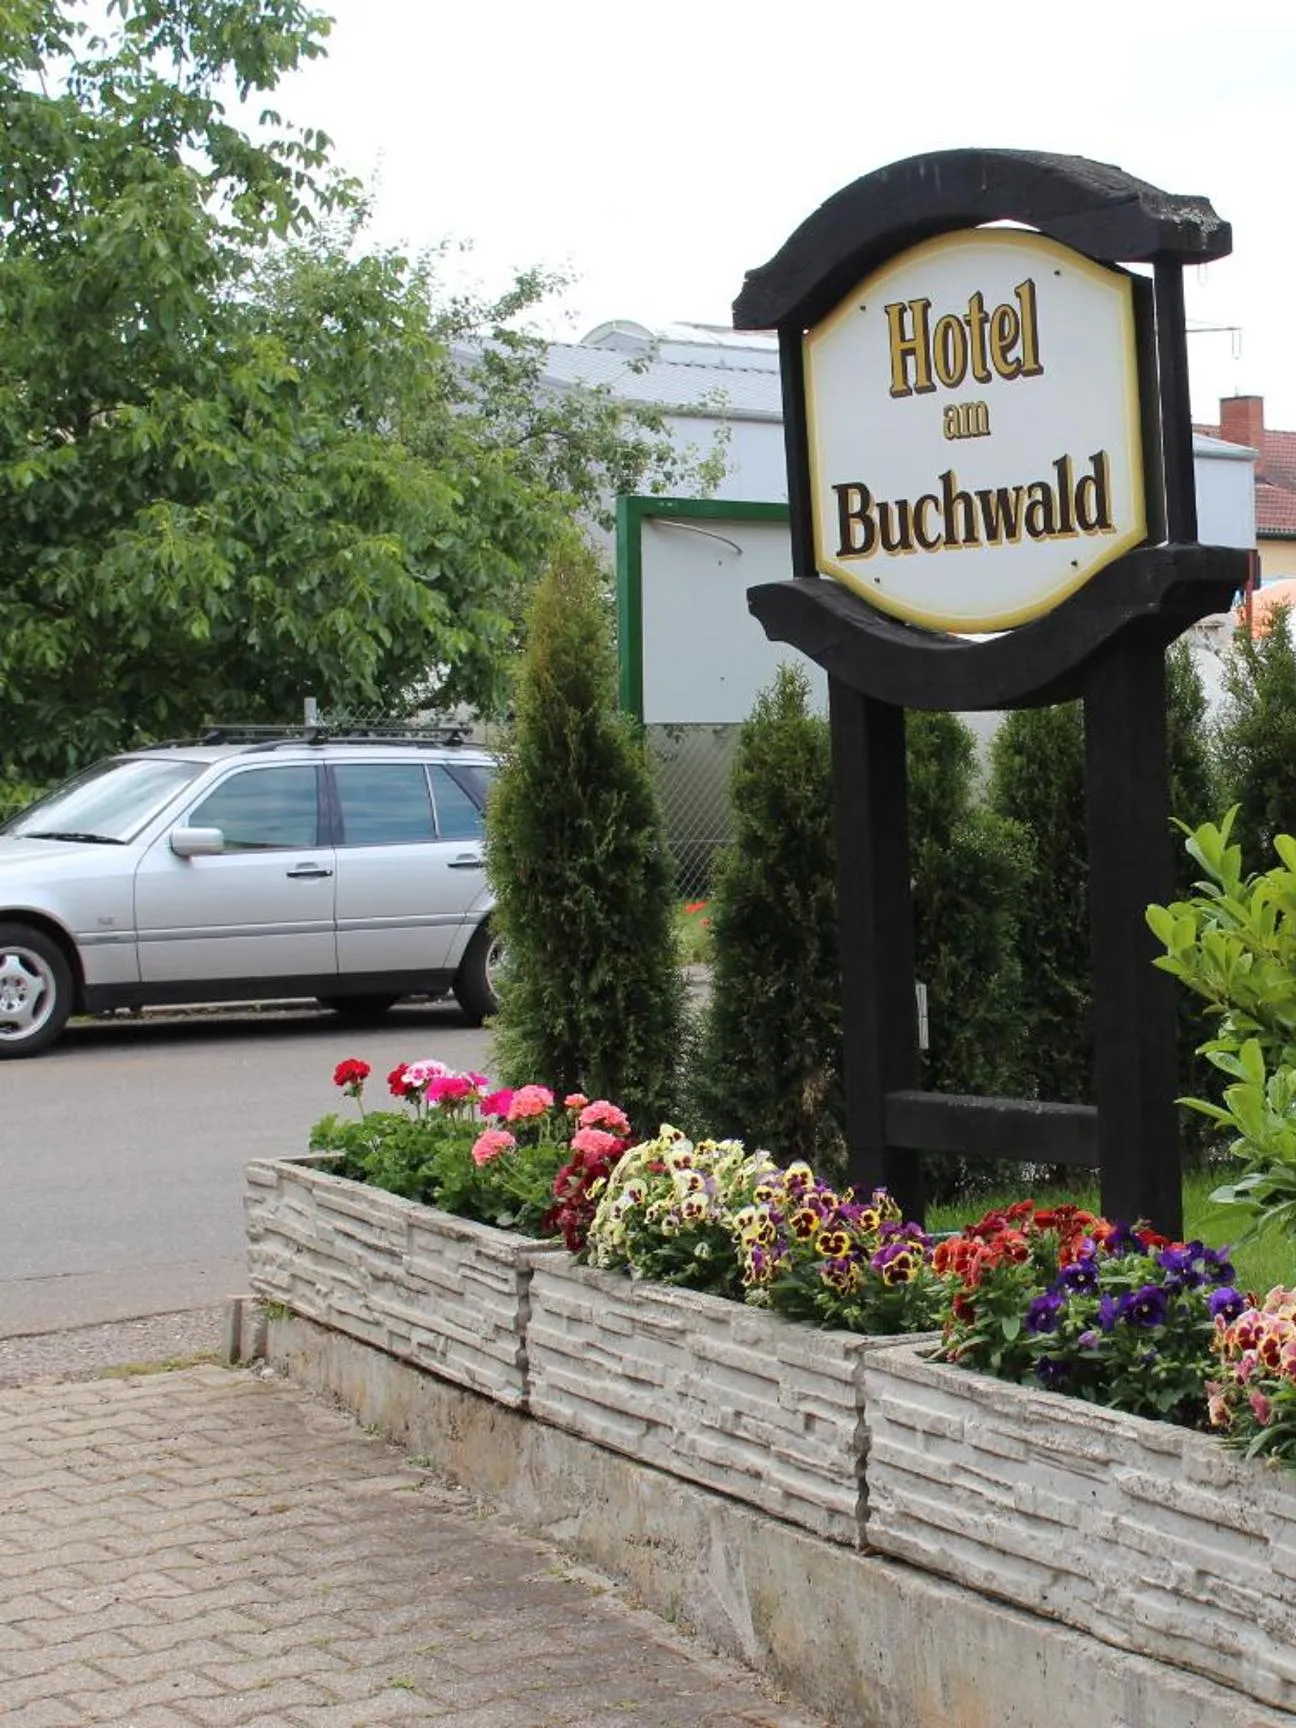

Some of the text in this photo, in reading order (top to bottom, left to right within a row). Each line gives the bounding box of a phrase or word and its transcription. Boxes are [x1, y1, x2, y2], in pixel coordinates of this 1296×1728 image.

[885, 279, 1043, 397] Hotel
[944, 401, 990, 440] am
[832, 450, 1116, 560] Buchwald
